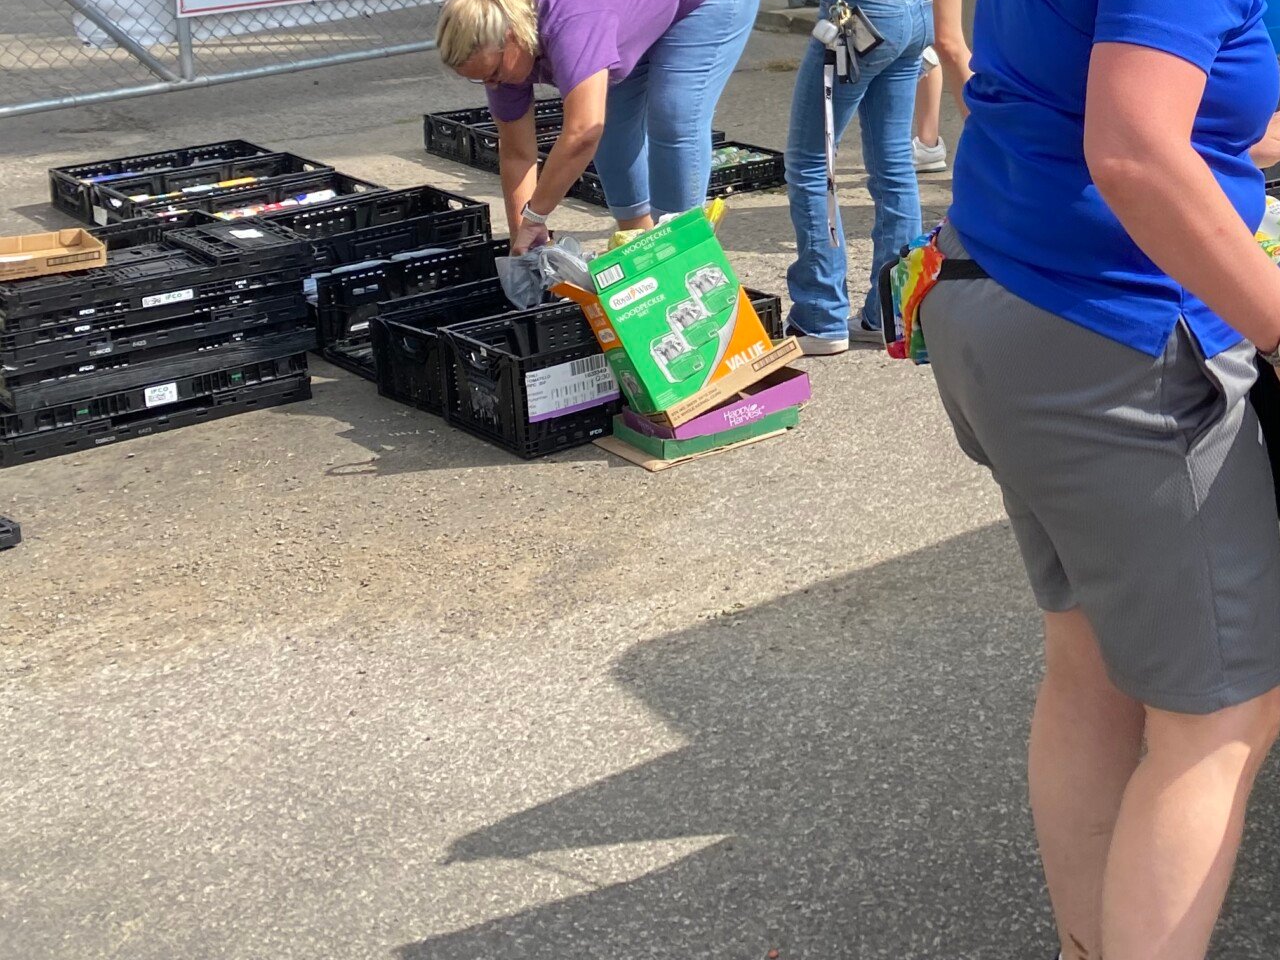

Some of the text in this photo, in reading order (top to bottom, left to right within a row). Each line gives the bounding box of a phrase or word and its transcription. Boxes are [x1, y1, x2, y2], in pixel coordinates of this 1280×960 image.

[622, 227, 672, 256] WOODPECKER
[165, 292, 183, 301] IFCO
[612, 281, 656, 308] Royal Wing
[616, 294, 666, 322] WOODPECKER
[726, 341, 765, 371] VALUE
[723, 403, 754, 422] Happy
[729, 408, 763, 427] Harvest
